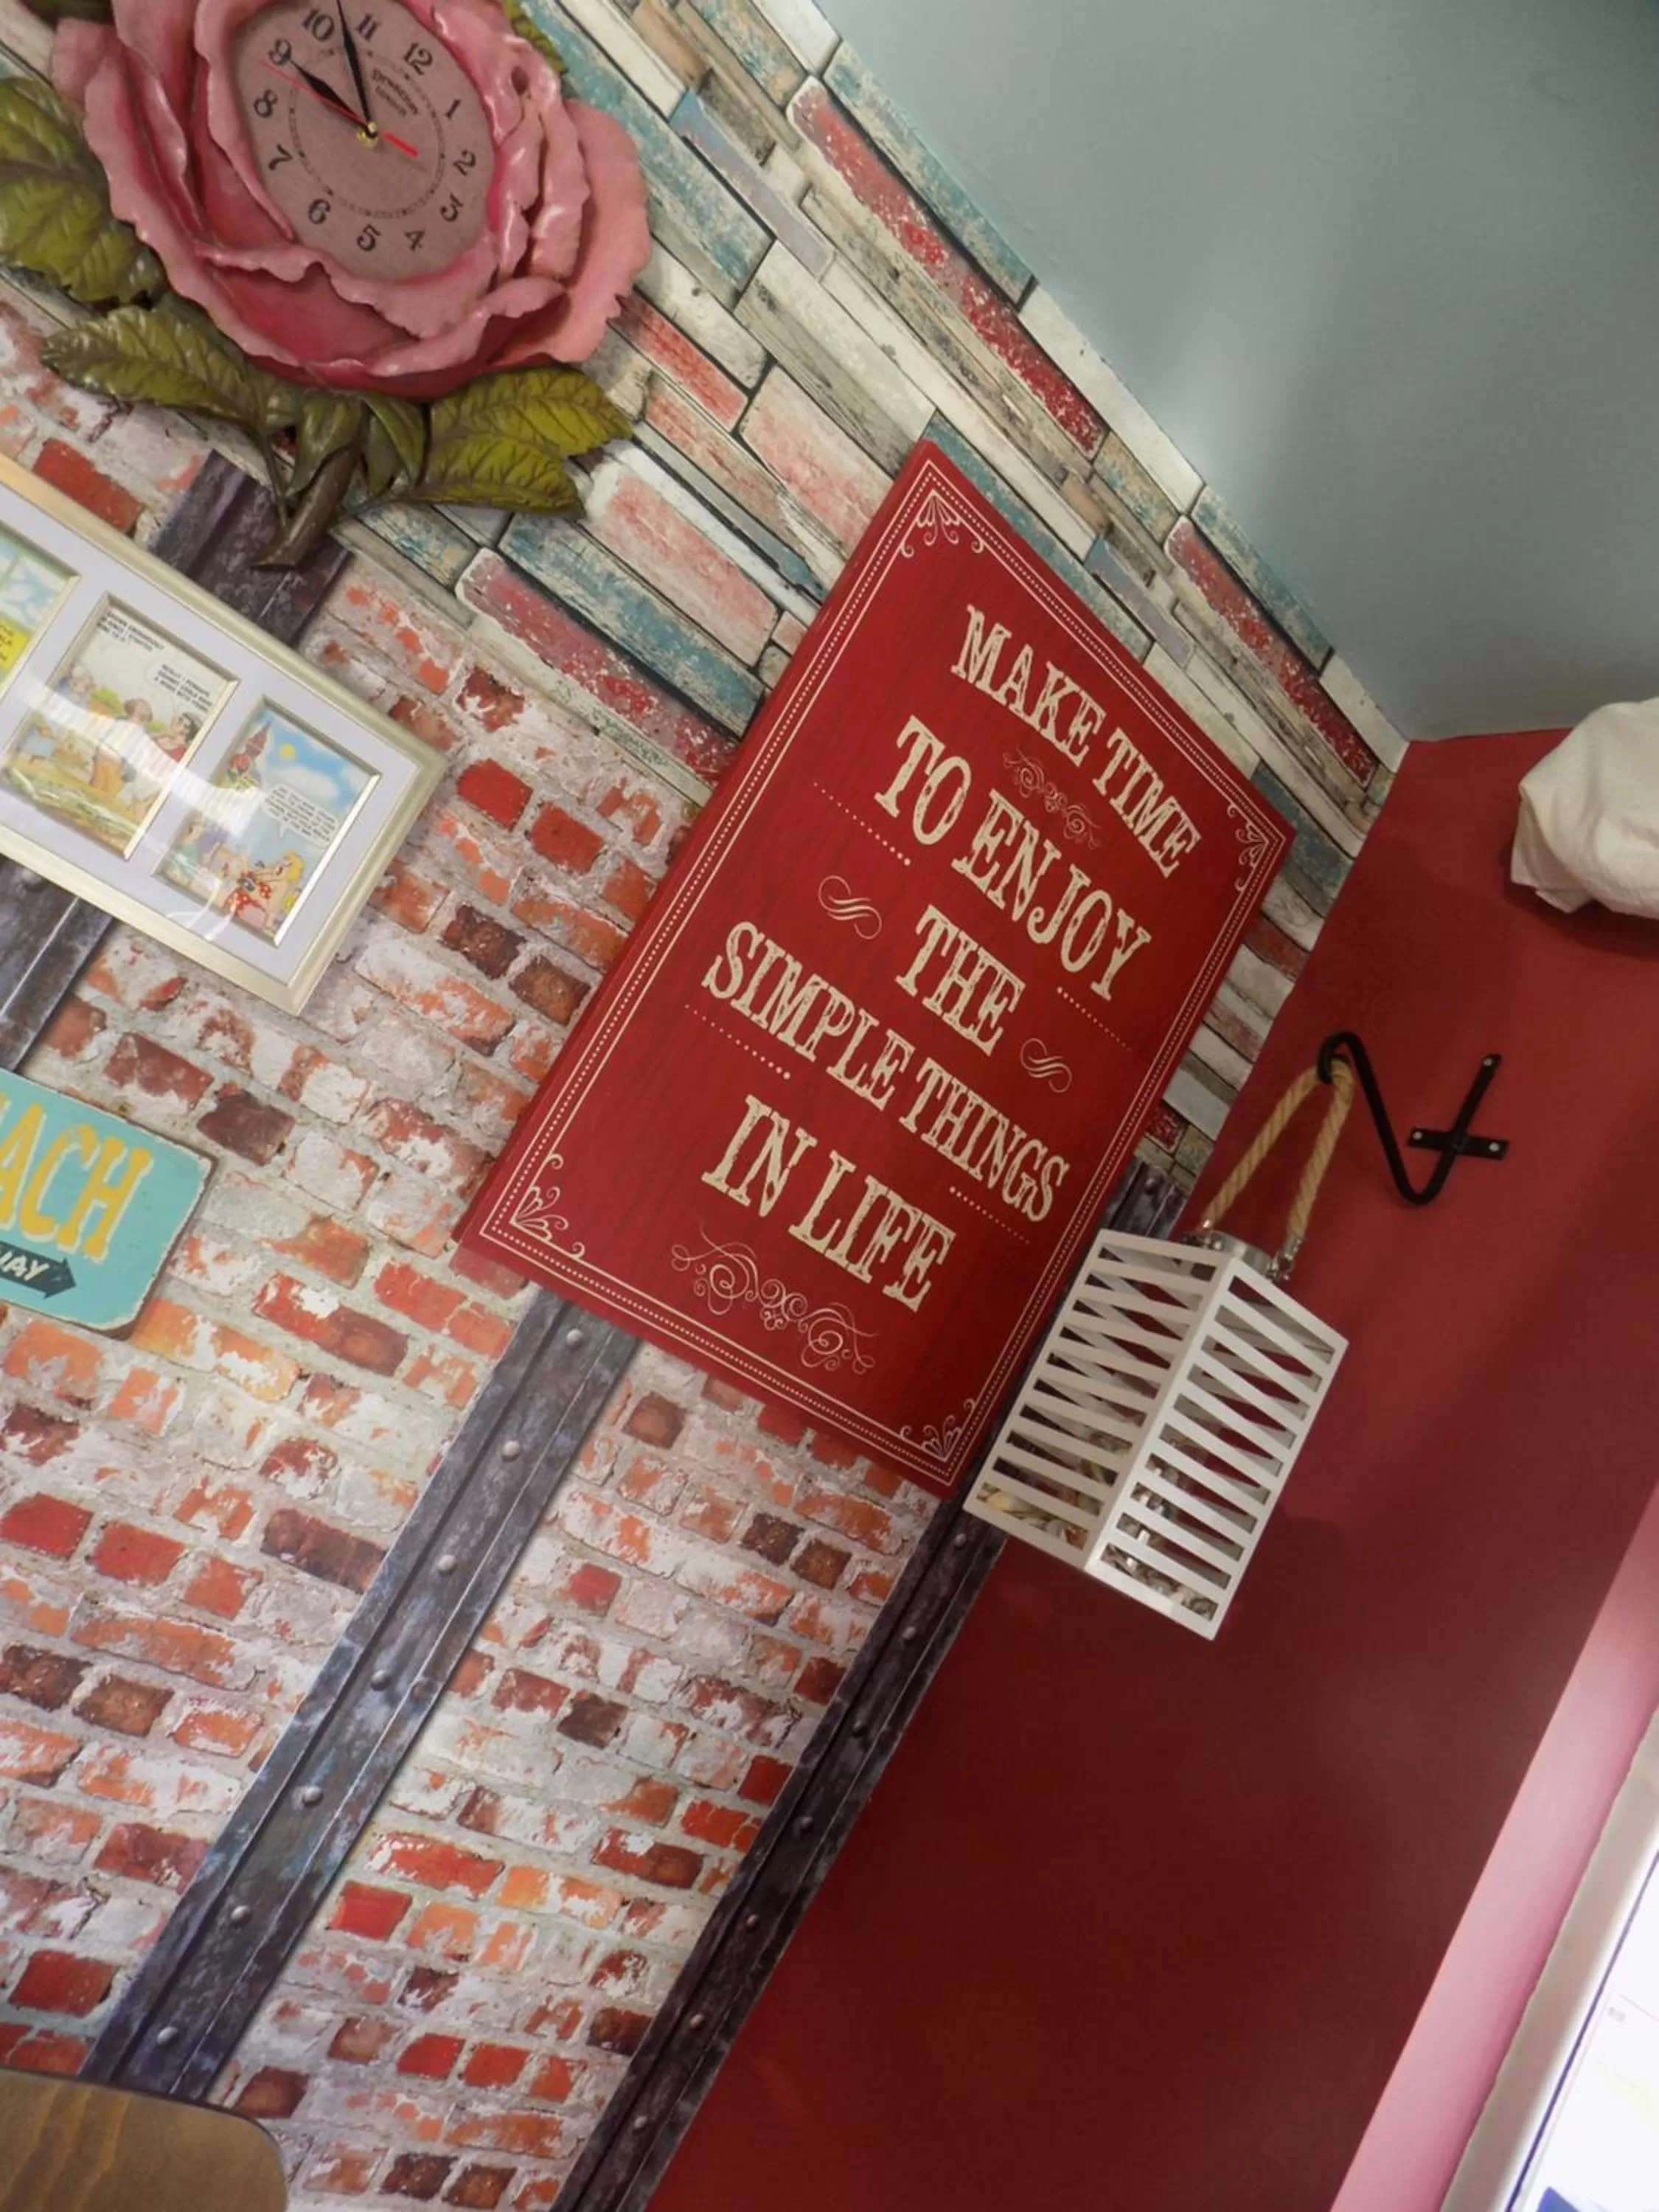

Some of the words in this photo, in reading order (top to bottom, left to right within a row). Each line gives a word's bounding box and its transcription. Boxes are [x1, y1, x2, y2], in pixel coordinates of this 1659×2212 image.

[302, 9, 335, 41] 10
[357, 14, 381, 41] 11
[268, 38, 292, 66] 9
[403, 42, 433, 76] 12
[253, 89, 278, 118] 8
[445, 99, 461, 119] 1
[268, 144, 293, 171] 7
[453, 150, 476, 177] 2
[307, 198, 331, 225] 6
[439, 193, 464, 223] 3
[356, 224, 382, 252] 5
[404, 229, 425, 251] 4
[950, 604, 1107, 767] MAKE
[1092, 727, 1202, 878] TIME
[874, 714, 972, 846] TO
[950, 788, 1152, 1001] ENJOY
[894, 904, 1026, 1057] THE
[701, 921, 915, 1111] SIMPLE
[899, 1057, 1070, 1222] THINGS
[0, 1091, 154, 1264] ACH
[701, 1094, 818, 1217] IN
[788, 1150, 956, 1312] LIFE
